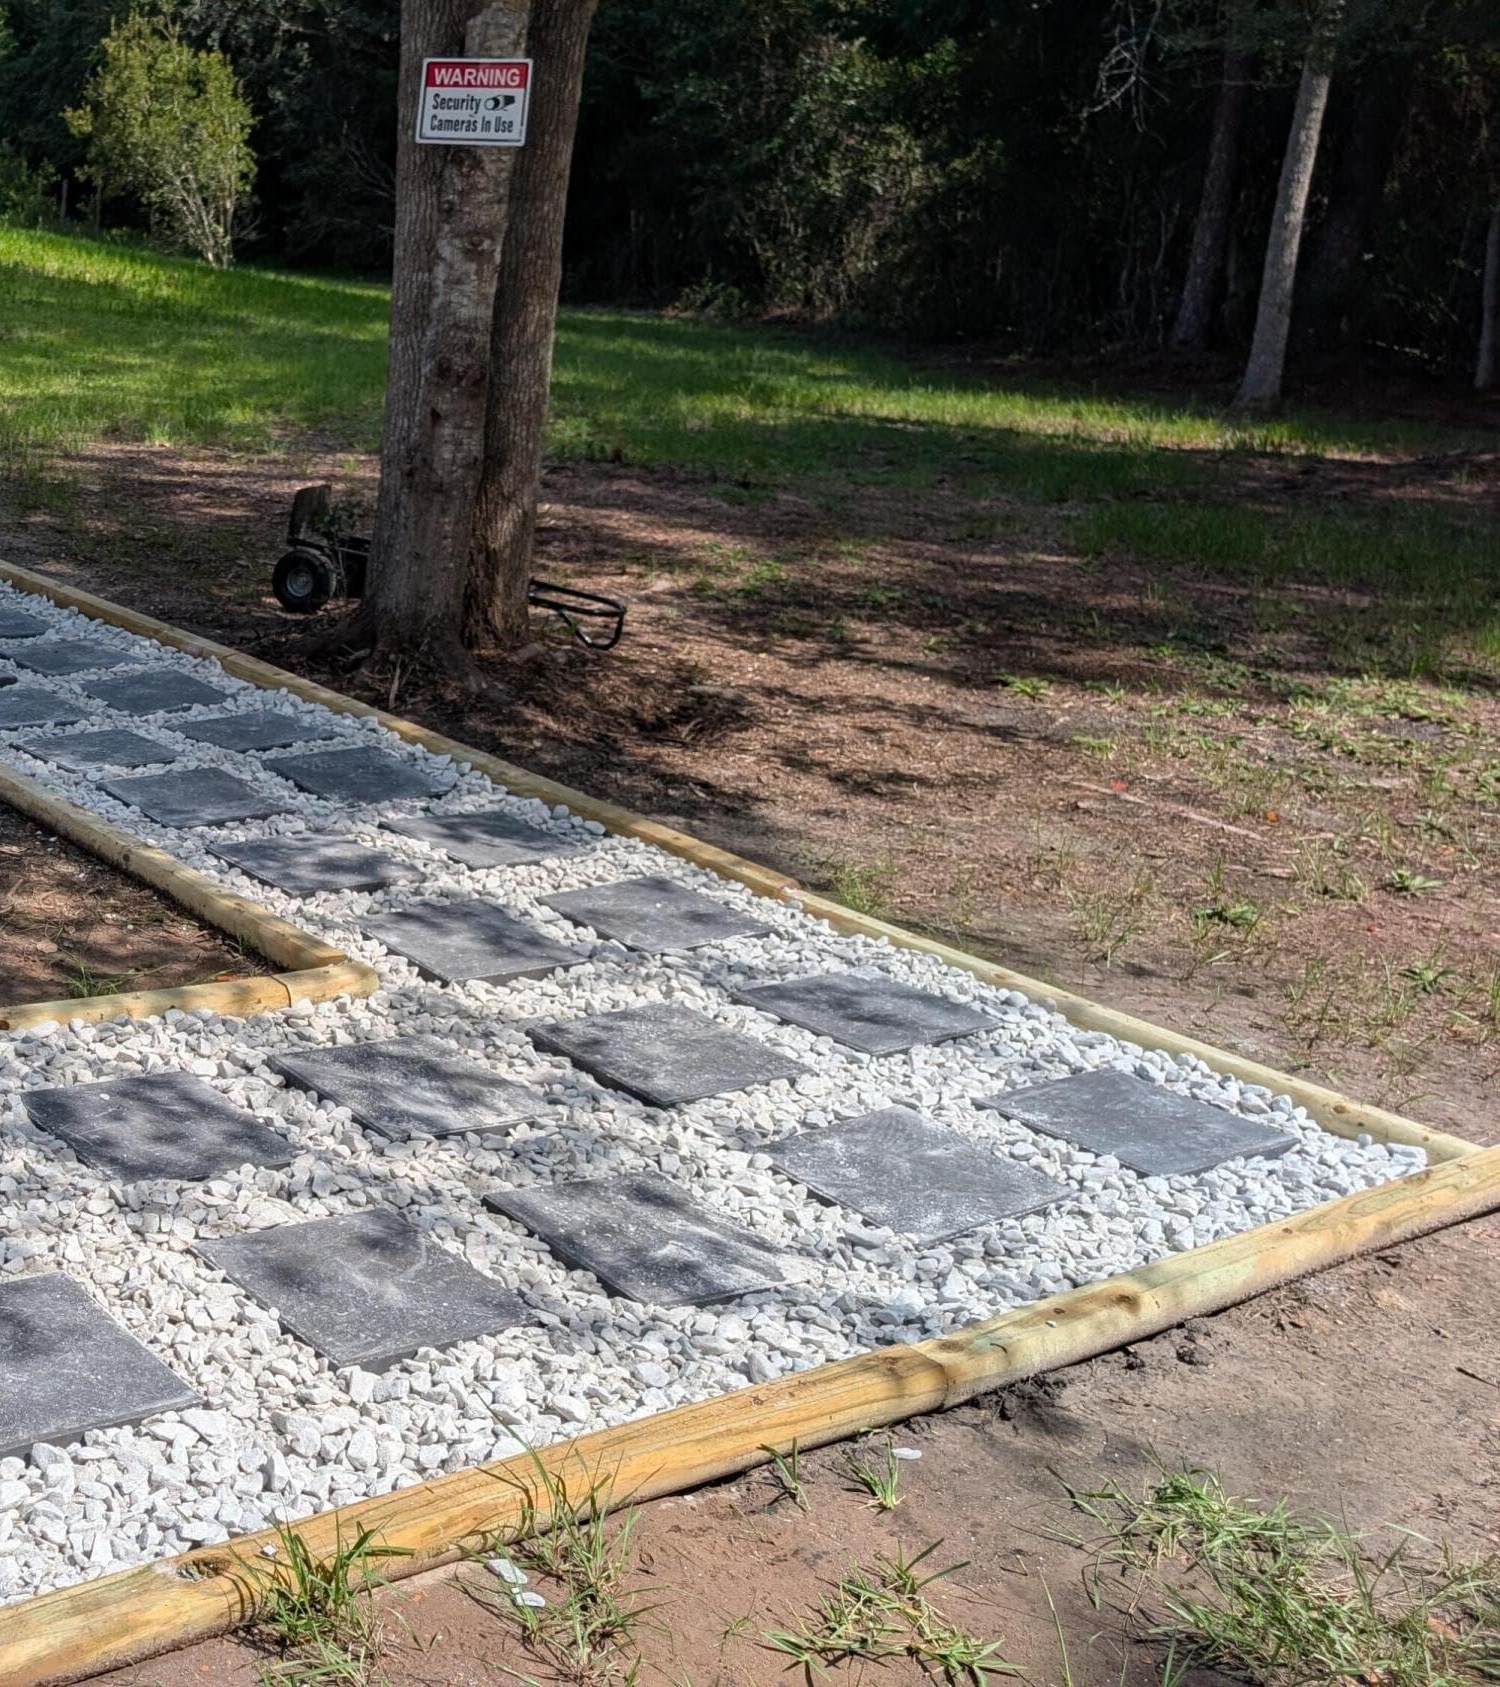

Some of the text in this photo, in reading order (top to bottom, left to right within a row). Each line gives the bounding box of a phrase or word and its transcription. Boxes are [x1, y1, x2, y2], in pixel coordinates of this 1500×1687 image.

[434, 68, 520, 86] WARNING
[432, 93, 481, 115] Security
[430, 114, 514, 134] Cameras In Use
